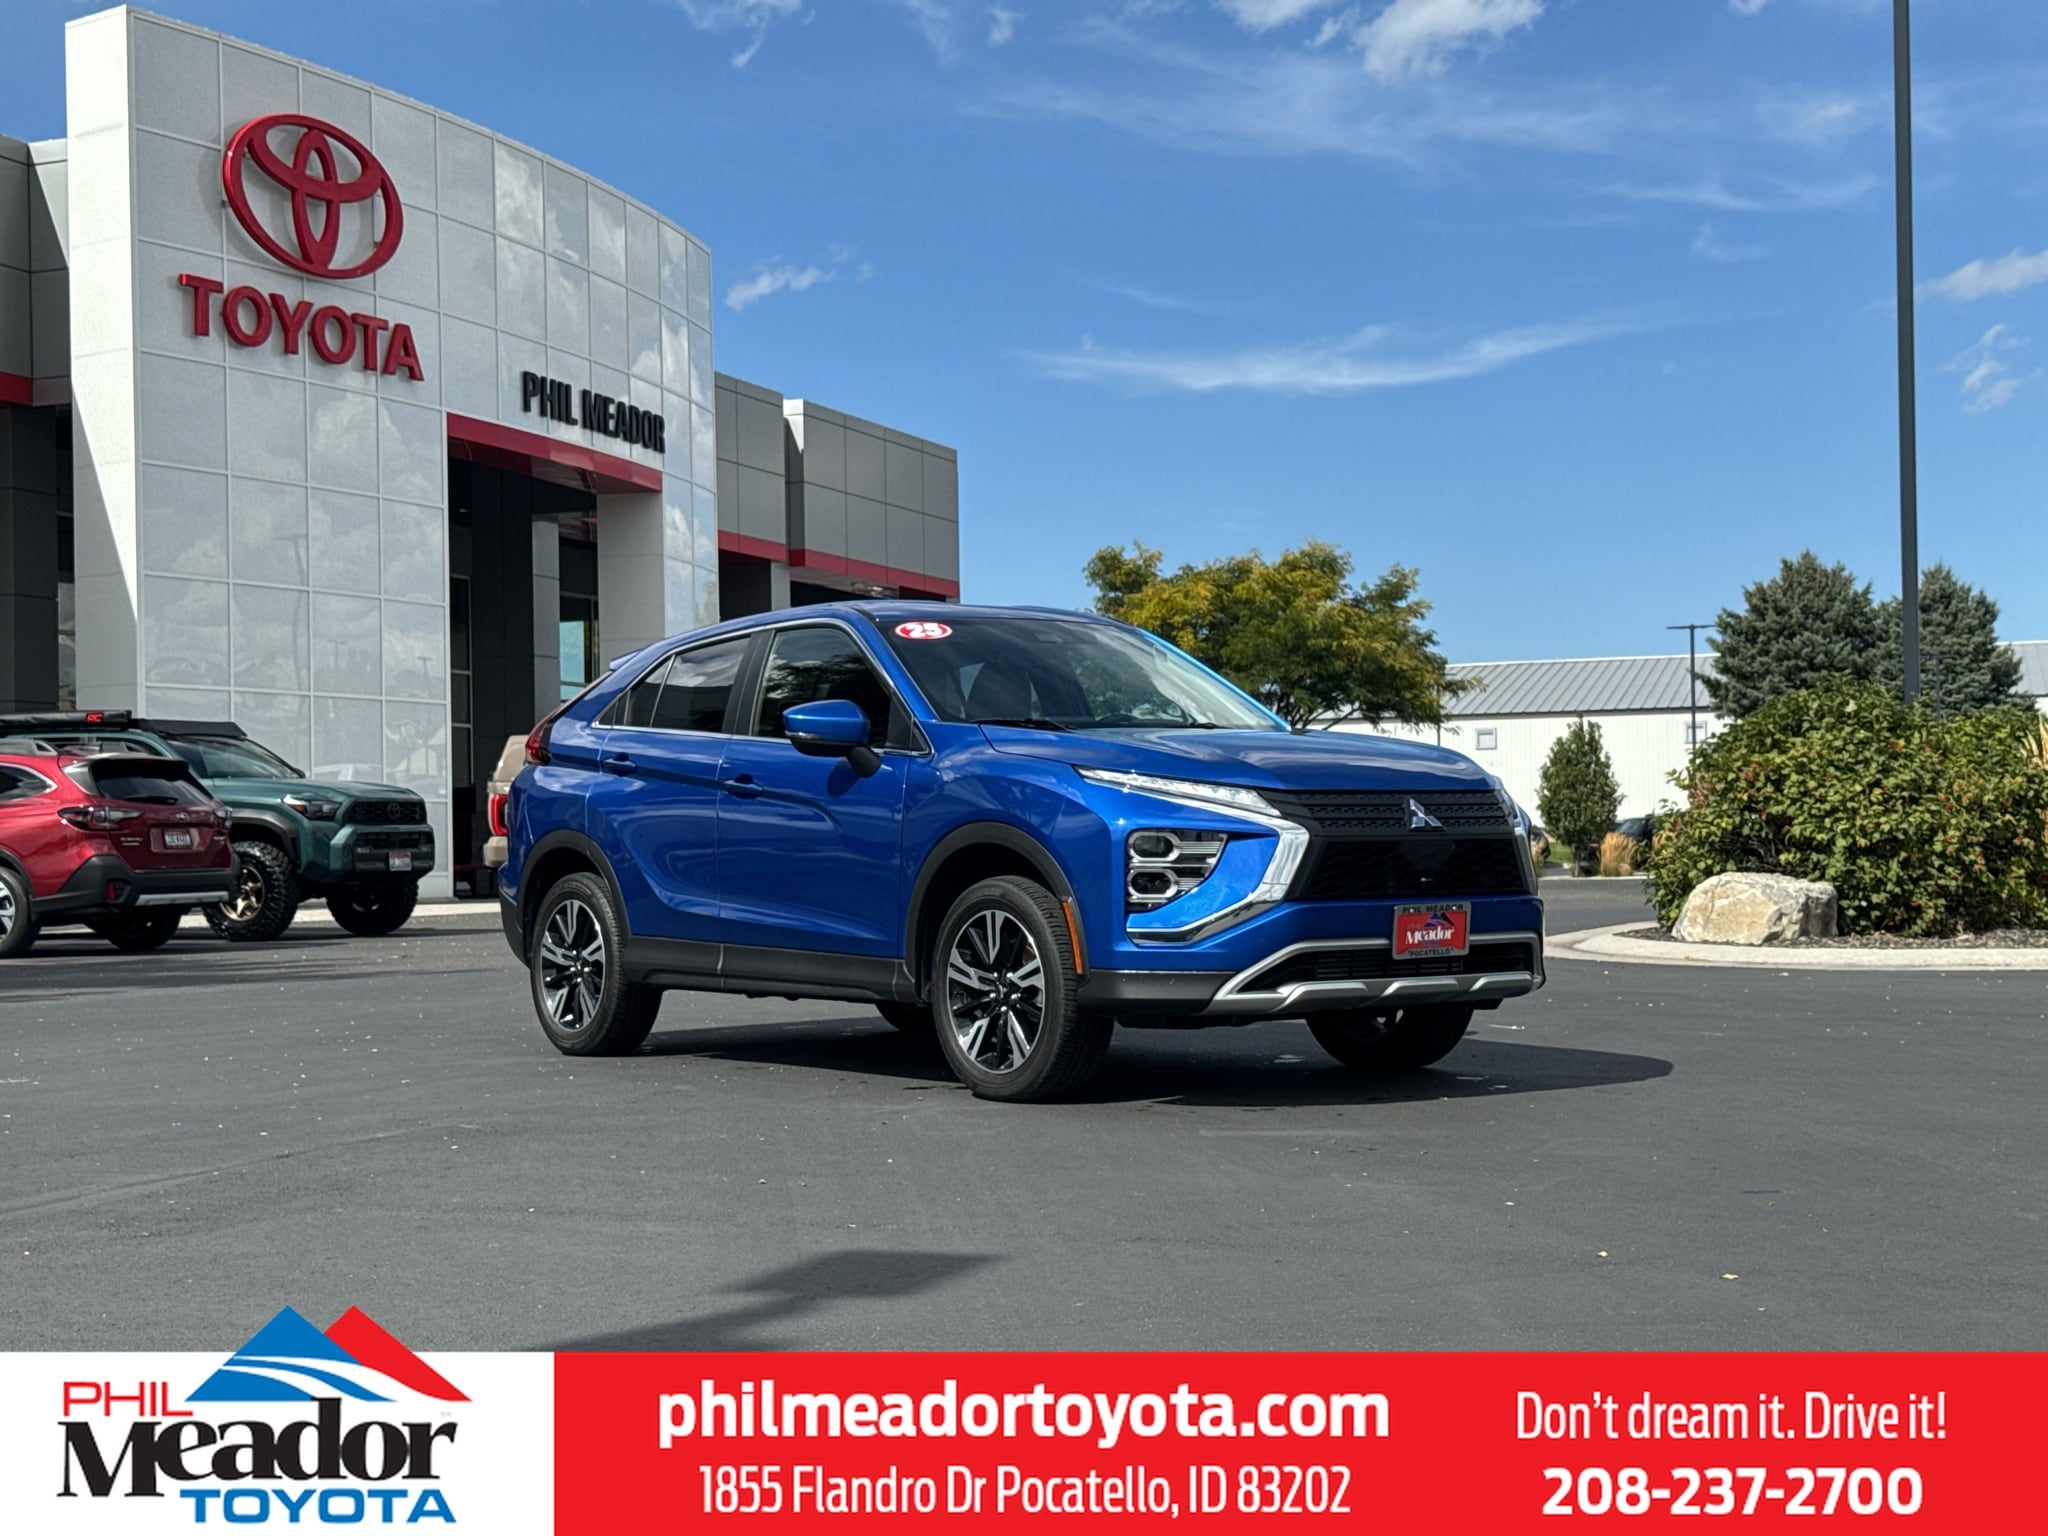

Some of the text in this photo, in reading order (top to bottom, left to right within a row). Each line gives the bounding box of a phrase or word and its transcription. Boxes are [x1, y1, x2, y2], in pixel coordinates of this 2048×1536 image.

[178, 272, 425, 382] TOYOTA
[522, 371, 666, 455] PHIL MEADOR
[905, 622, 943, 639] 25
[1426, 903, 1464, 913] MEADOR
[1405, 925, 1456, 945] Meador
